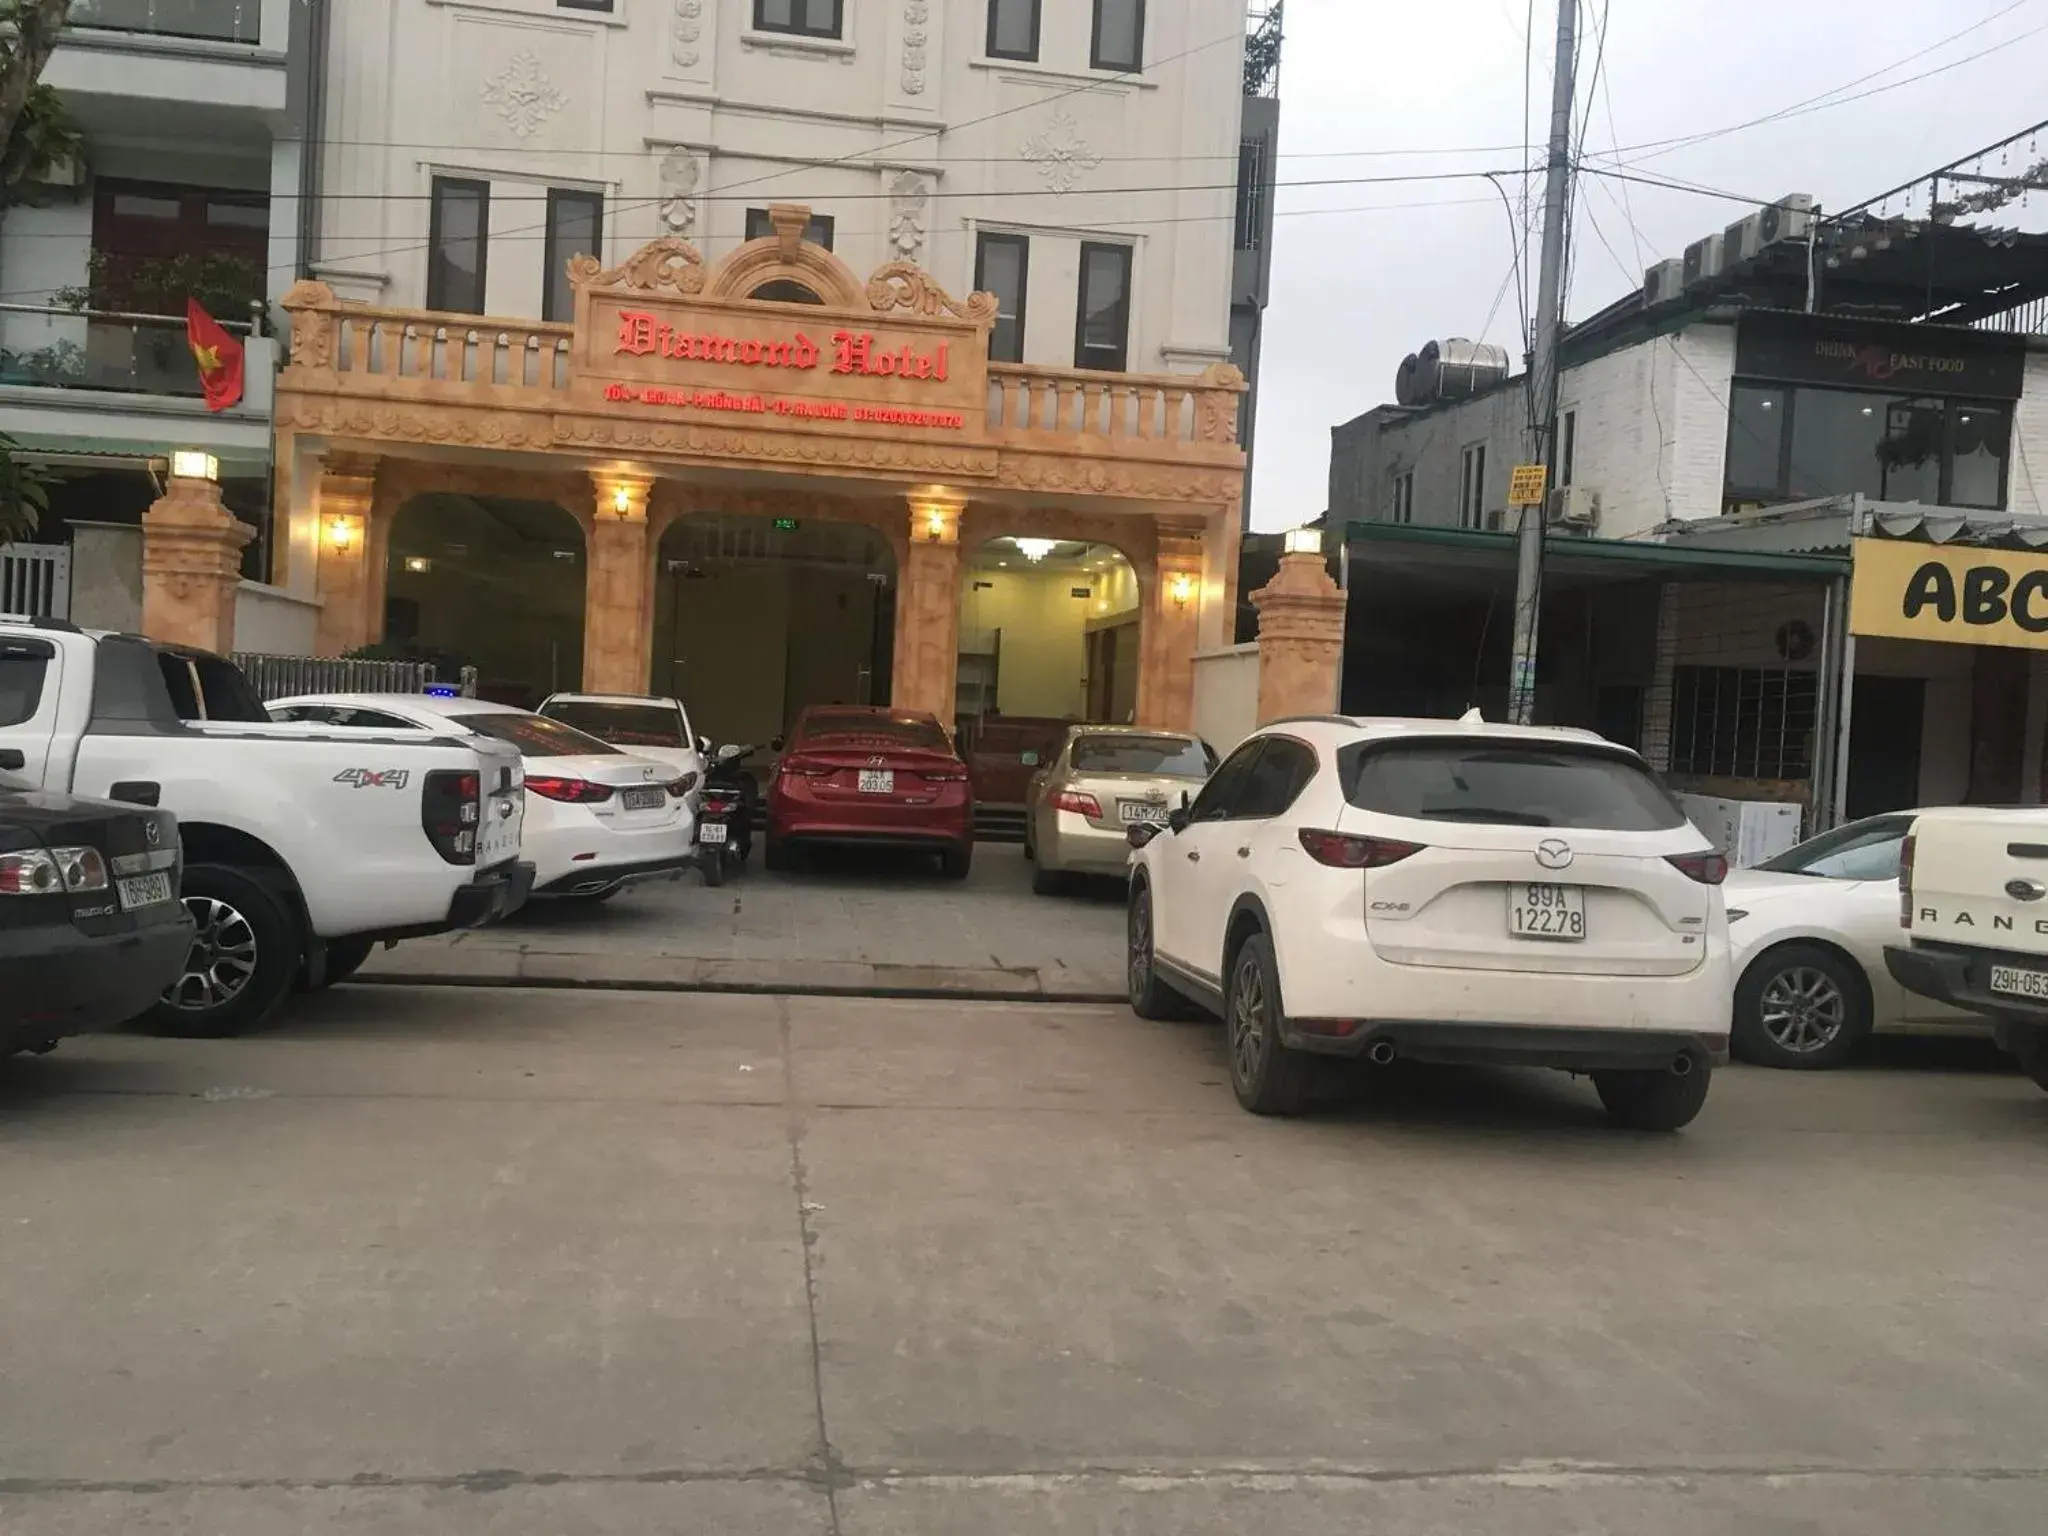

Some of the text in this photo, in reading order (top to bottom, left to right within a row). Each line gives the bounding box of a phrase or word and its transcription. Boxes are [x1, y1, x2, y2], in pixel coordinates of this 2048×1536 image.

[613, 309, 949, 381] Diamond Hotel
[1903, 562, 2048, 633] ABC
[333, 768, 410, 789] 4x4
[1527, 884, 1567, 909] 89A
[1515, 906, 1582, 934] 122.78
